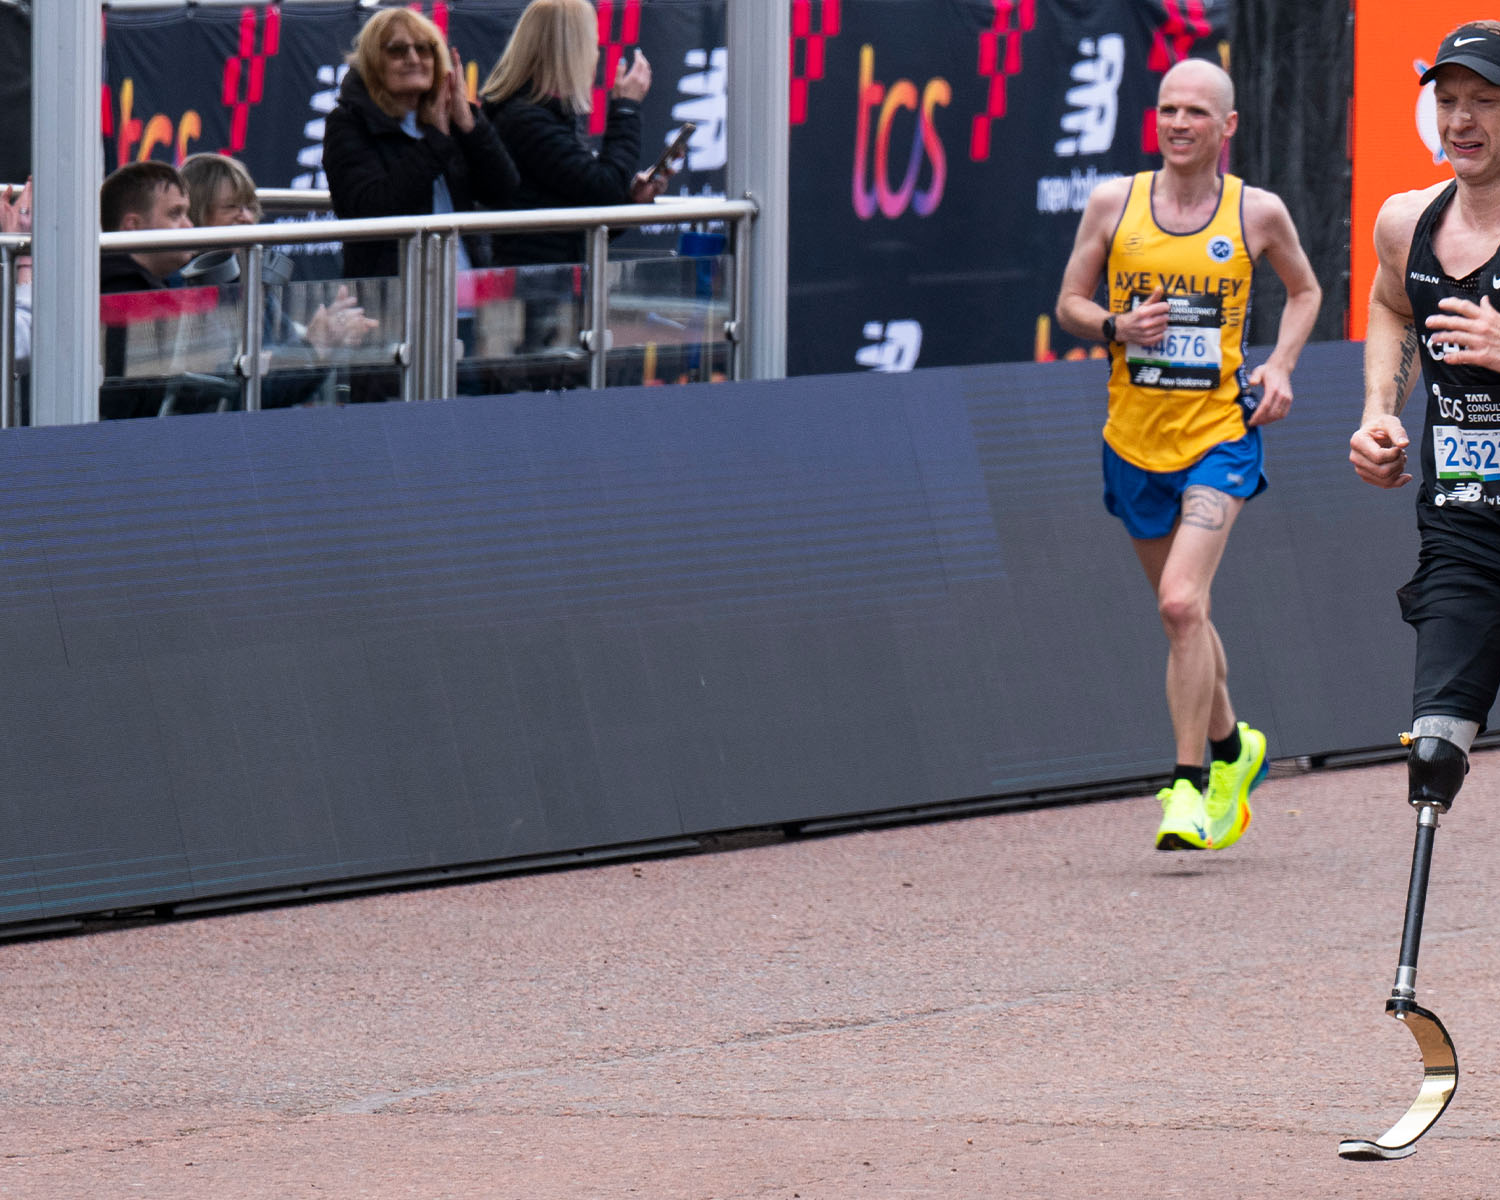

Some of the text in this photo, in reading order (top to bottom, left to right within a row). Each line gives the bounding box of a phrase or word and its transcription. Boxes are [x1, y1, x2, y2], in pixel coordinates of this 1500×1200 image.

[852, 44, 952, 220] tcs
[1115, 271, 1244, 298] AXE VALLEY
[1438, 392, 1464, 422] tcs
[1465, 394, 1491, 402] TATA
